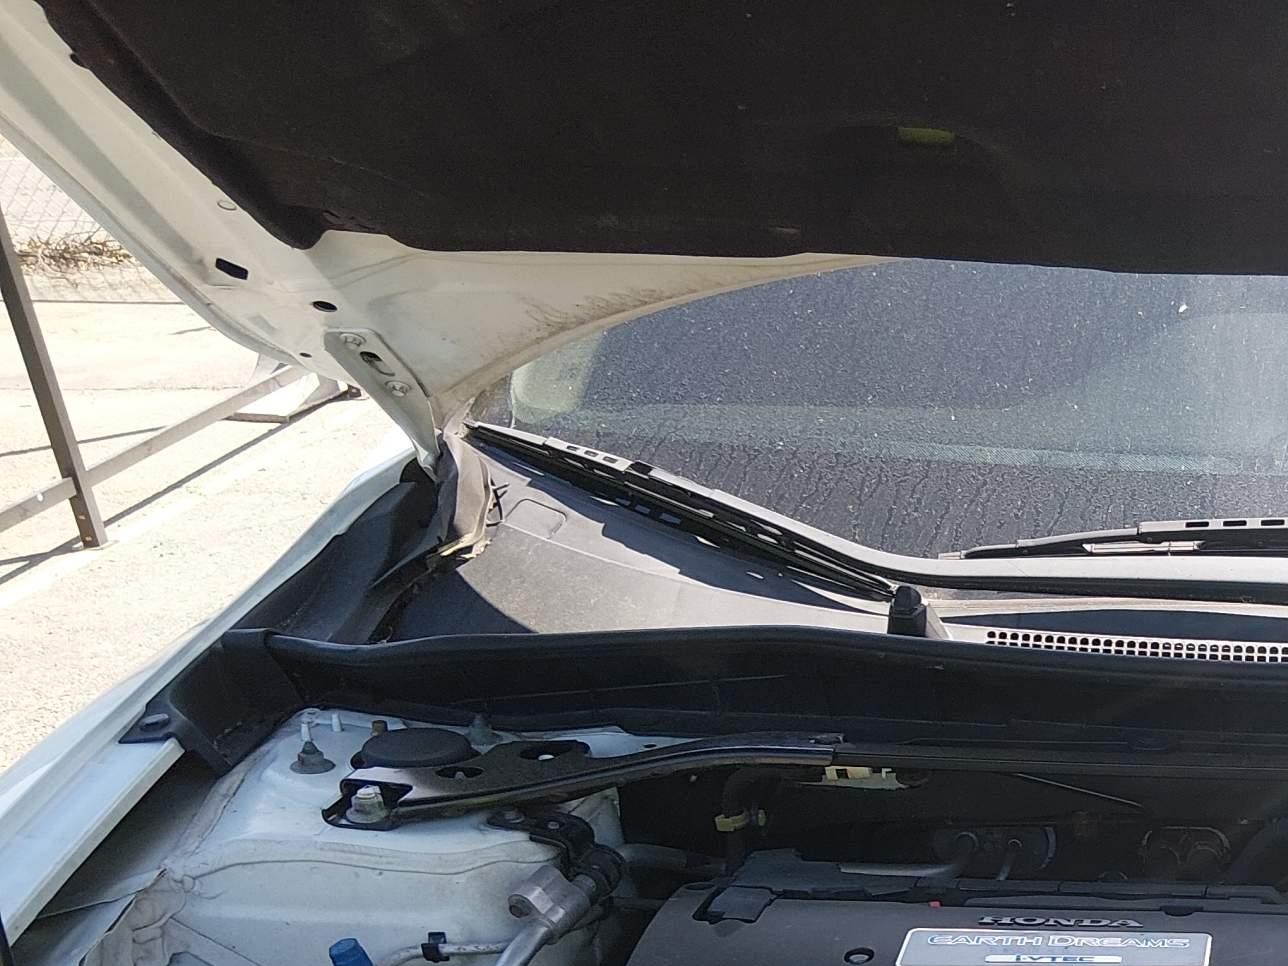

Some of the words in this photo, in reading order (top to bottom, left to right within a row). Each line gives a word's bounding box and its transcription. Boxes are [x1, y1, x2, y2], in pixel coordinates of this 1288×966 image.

[978, 915, 1144, 928] HONDA
[927, 934, 1042, 948] EARTH
[1047, 935, 1190, 949] DREAMS
